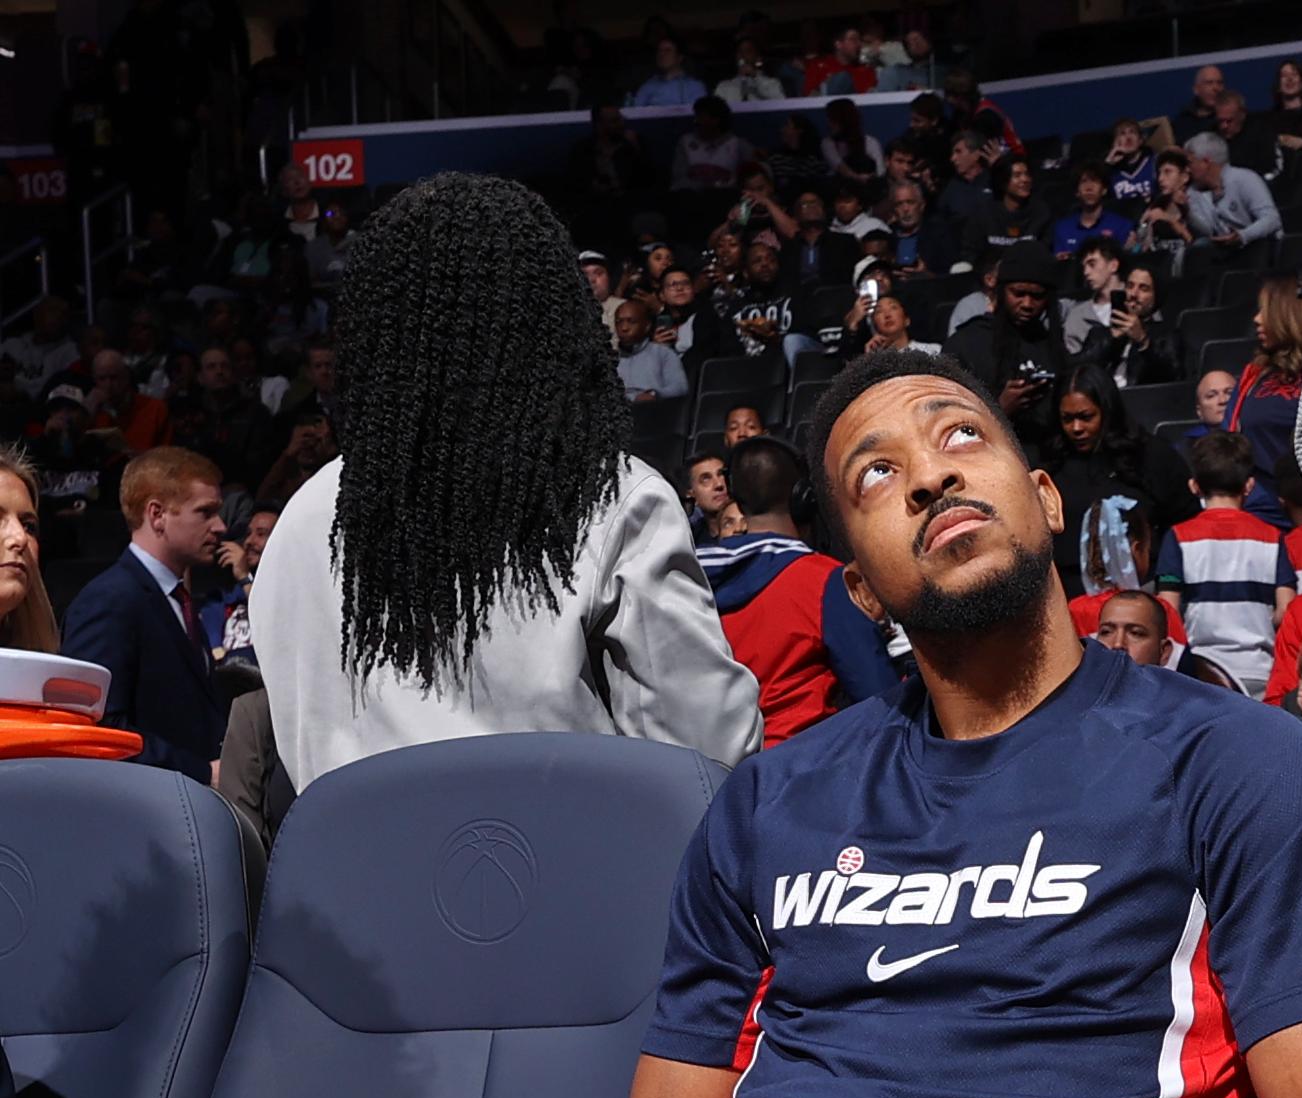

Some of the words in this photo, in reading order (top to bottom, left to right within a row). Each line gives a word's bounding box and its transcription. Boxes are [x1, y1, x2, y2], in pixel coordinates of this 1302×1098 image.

[304, 153, 354, 182] 102
[19, 170, 66, 199] 103
[772, 830, 1101, 930] wizards
